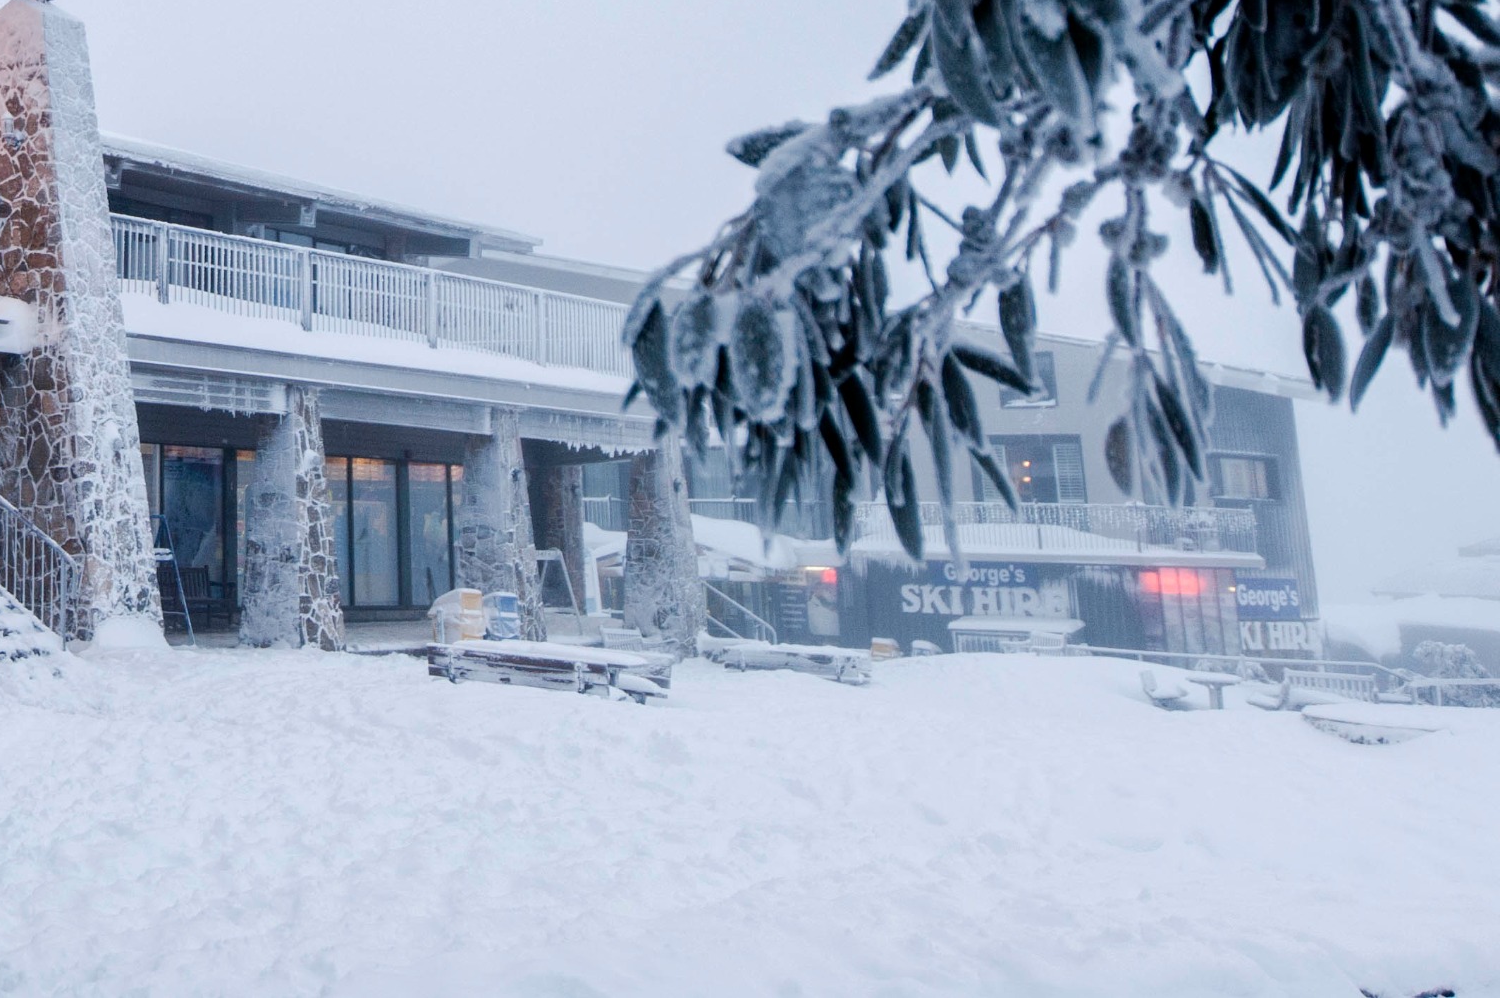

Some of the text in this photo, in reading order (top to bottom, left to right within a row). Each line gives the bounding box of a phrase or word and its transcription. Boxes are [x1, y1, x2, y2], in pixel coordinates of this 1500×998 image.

[943, 562, 1026, 586] Gorge's
[900, 583, 1069, 618] SKI HIR
[1236, 583, 1299, 612] George's
